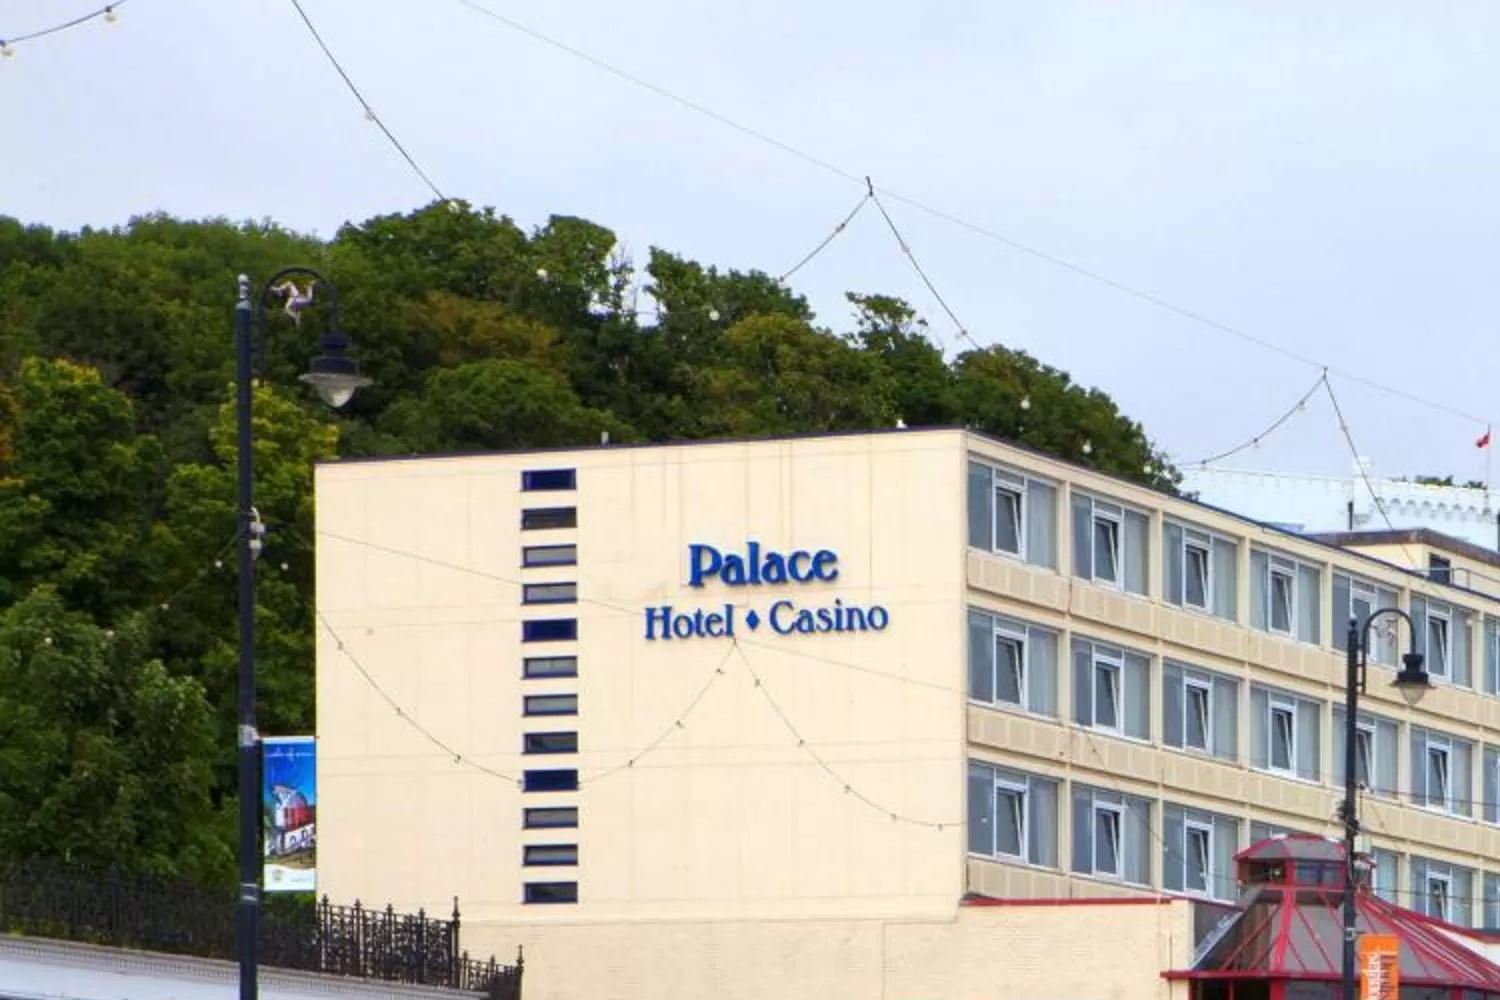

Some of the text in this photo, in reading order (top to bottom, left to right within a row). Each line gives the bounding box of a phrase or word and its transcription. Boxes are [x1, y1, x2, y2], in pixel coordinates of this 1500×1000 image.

[688, 541, 840, 588] Palace
[645, 598, 889, 641] Hotel Casino
